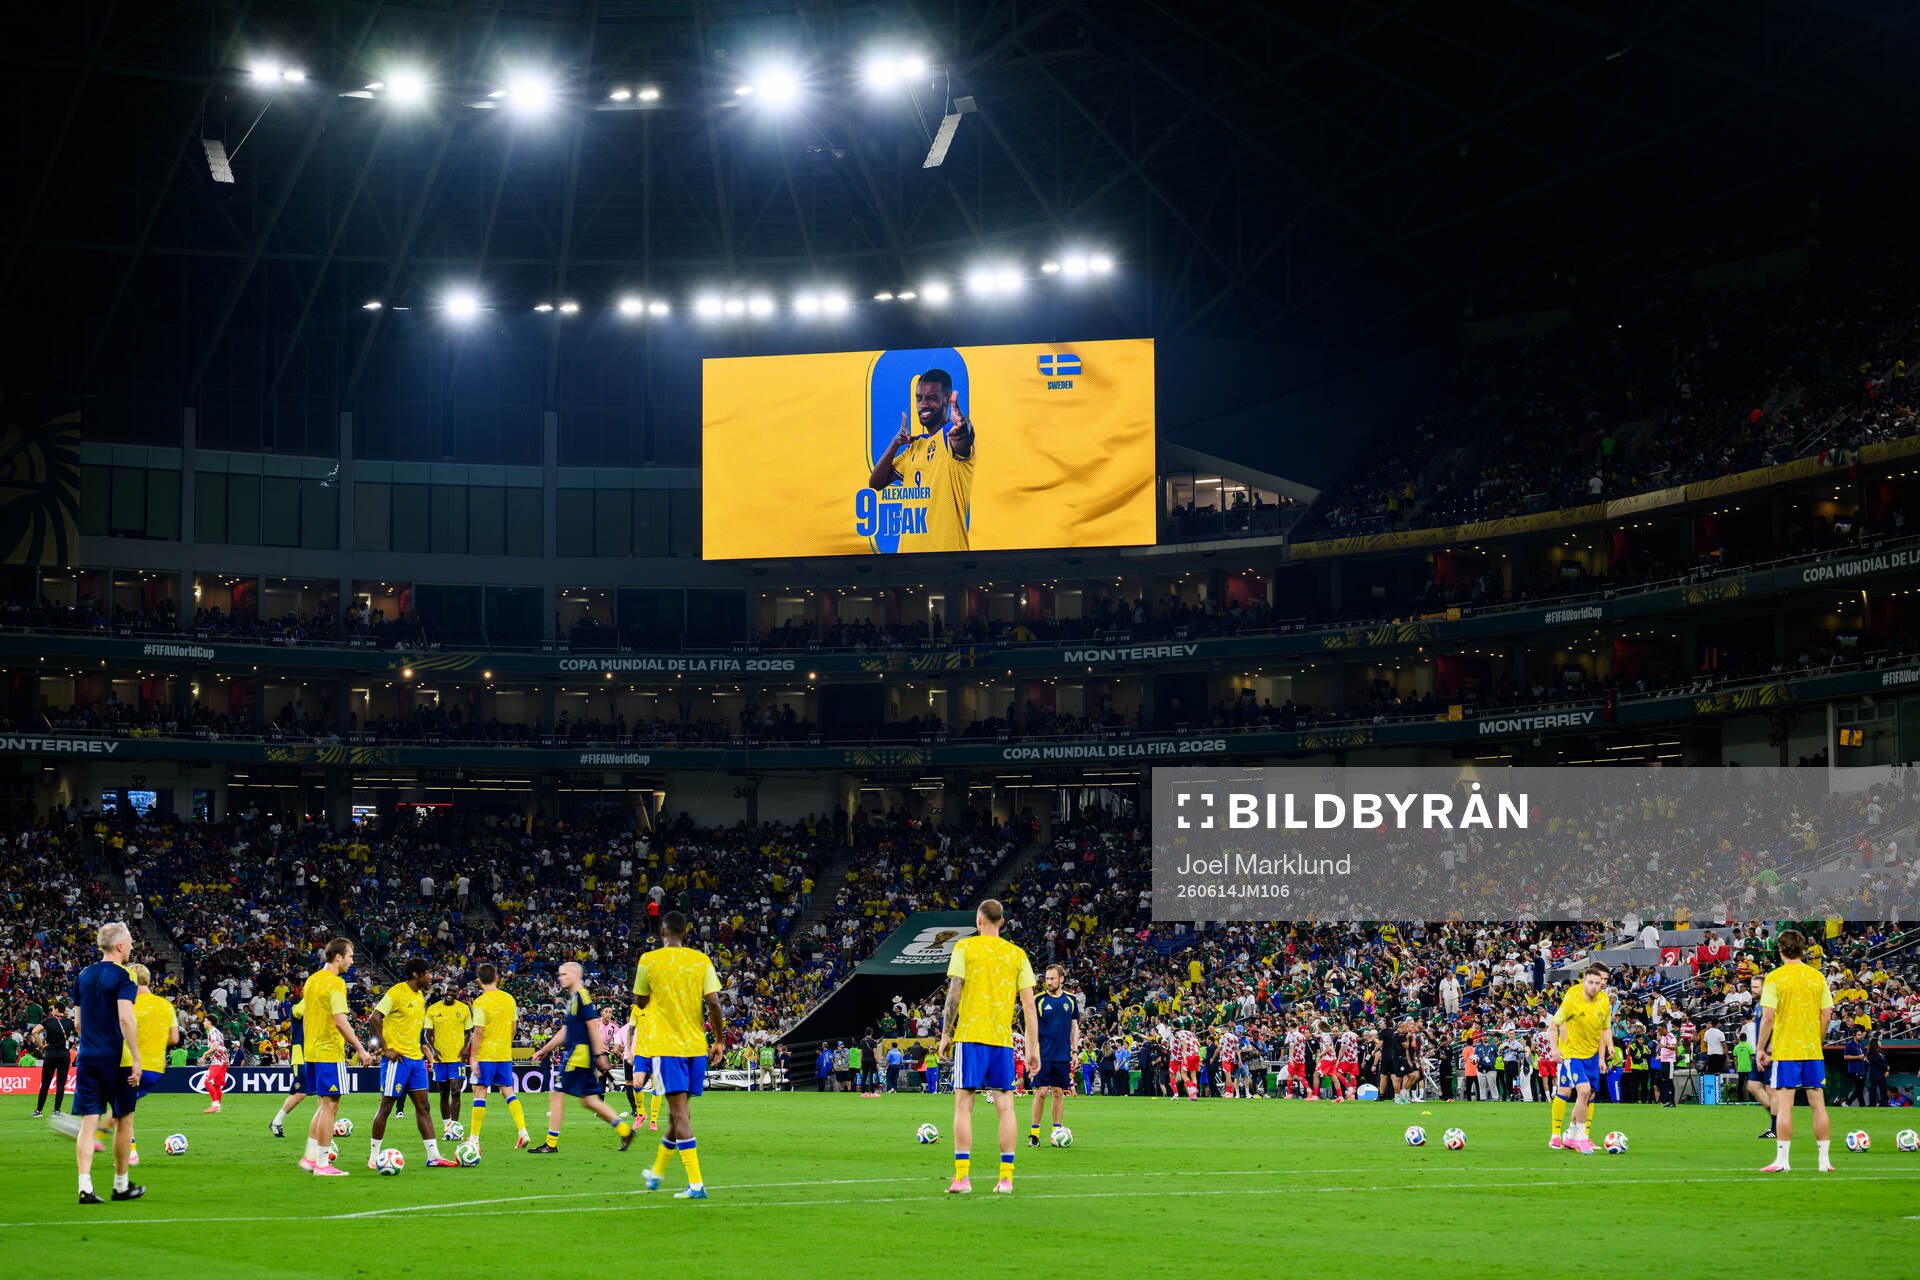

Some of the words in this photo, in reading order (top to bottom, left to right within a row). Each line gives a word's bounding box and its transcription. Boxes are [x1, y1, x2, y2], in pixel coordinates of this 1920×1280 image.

[1047, 380, 1073, 390] SWEDEN
[881, 486, 931, 500] ALEXANDER
[855, 488, 877, 537] 9
[1803, 565, 1834, 583] COPA
[1836, 555, 1889, 578] MUNDIAL
[1891, 551, 1908, 567] DE
[1544, 606, 1603, 625] #FIFAWorldCup
[143, 644, 215, 660] #FIFAWorldCup
[1063, 643, 1199, 663] MONTERREY
[559, 658, 598, 671] COPA
[600, 658, 666, 671] MUNDIAL
[668, 658, 688, 671] DE
[689, 658, 708, 671] LA
[710, 659, 741, 671] FIFA
[745, 659, 796, 671] 2026
[1479, 711, 1594, 735] MONTERREY
[1003, 746, 1042, 760] COPA
[1043, 744, 1105, 760] MUNDIAL
[1108, 744, 1126, 757] DE
[1128, 743, 1146, 757] LA
[1148, 741, 1177, 755] FIFA
[1179, 739, 1226, 754] 2026
[580, 753, 650, 766] #FIFAWorldCup
[131, 775, 146, 788] 32
[734, 786, 747, 799] 34
[457, 1066, 466, 1076] 13
[242, 1073, 358, 1092] HYUI
